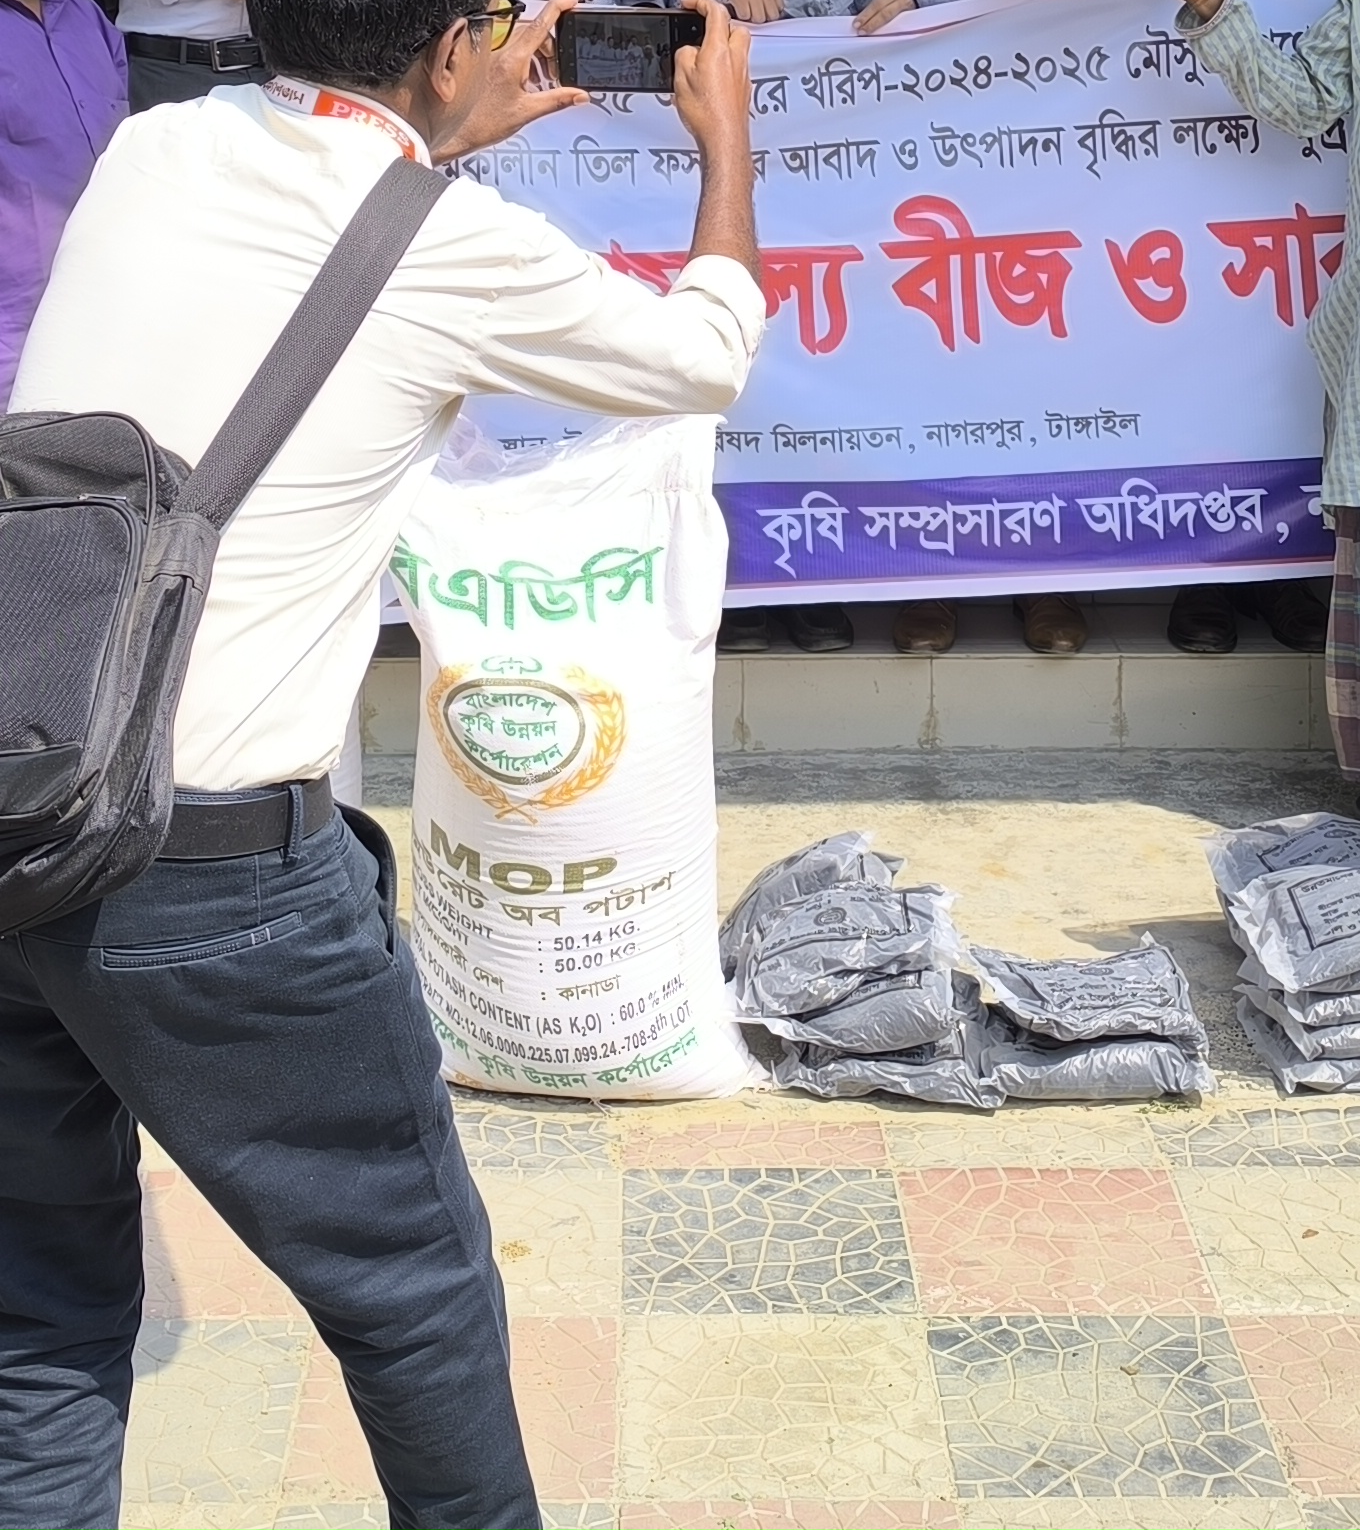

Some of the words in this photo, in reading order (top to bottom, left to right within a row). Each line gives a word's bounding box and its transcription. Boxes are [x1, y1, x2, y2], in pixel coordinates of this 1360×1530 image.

[801, 45, 1110, 109] খরিপ-২০২৪-২০২৫
[329, 100, 411, 147] PRESS
[570, 134, 640, 187] তিল
[779, 137, 880, 183] আবাদ
[891, 139, 919, 171] ও
[929, 121, 1066, 169] উৎপাদন
[1074, 108, 1162, 180] বৃদ্ধির
[1171, 113, 1262, 157] লক্ষ্যে
[878, 194, 1083, 354] বীজ
[1104, 228, 1188, 325] ও
[1044, 407, 1141, 440] টাঙ্গাইল
[756, 490, 850, 579] কৃষি
[857, 492, 1068, 557] সম্প্রসারণ
[458, 711, 496, 737] কৃষি
[501, 716, 558, 741] উন্নয়ন
[462, 692, 558, 716] বাংলাদেশ
[463, 731, 564, 773] কর্পোরেশন
[430, 818, 618, 896] MOP
[436, 891, 494, 939] WEIGHT
[553, 931, 603, 952] 50.14
[609, 920, 641, 942] KG.
[499, 901, 567, 927] অব
[582, 870, 677, 917] পটাশ
[473, 966, 505, 994] দেশ
[555, 974, 622, 1002] কানাডা
[554, 952, 604, 974] 50.00
[469, 990, 531, 1033] CONTENT
[536, 1016, 562, 1039] (AS
[619, 997, 646, 1021] 60.0
[474, 1048, 517, 1081] কৃষি
[521, 1063, 588, 1090] উন্নয়ন
